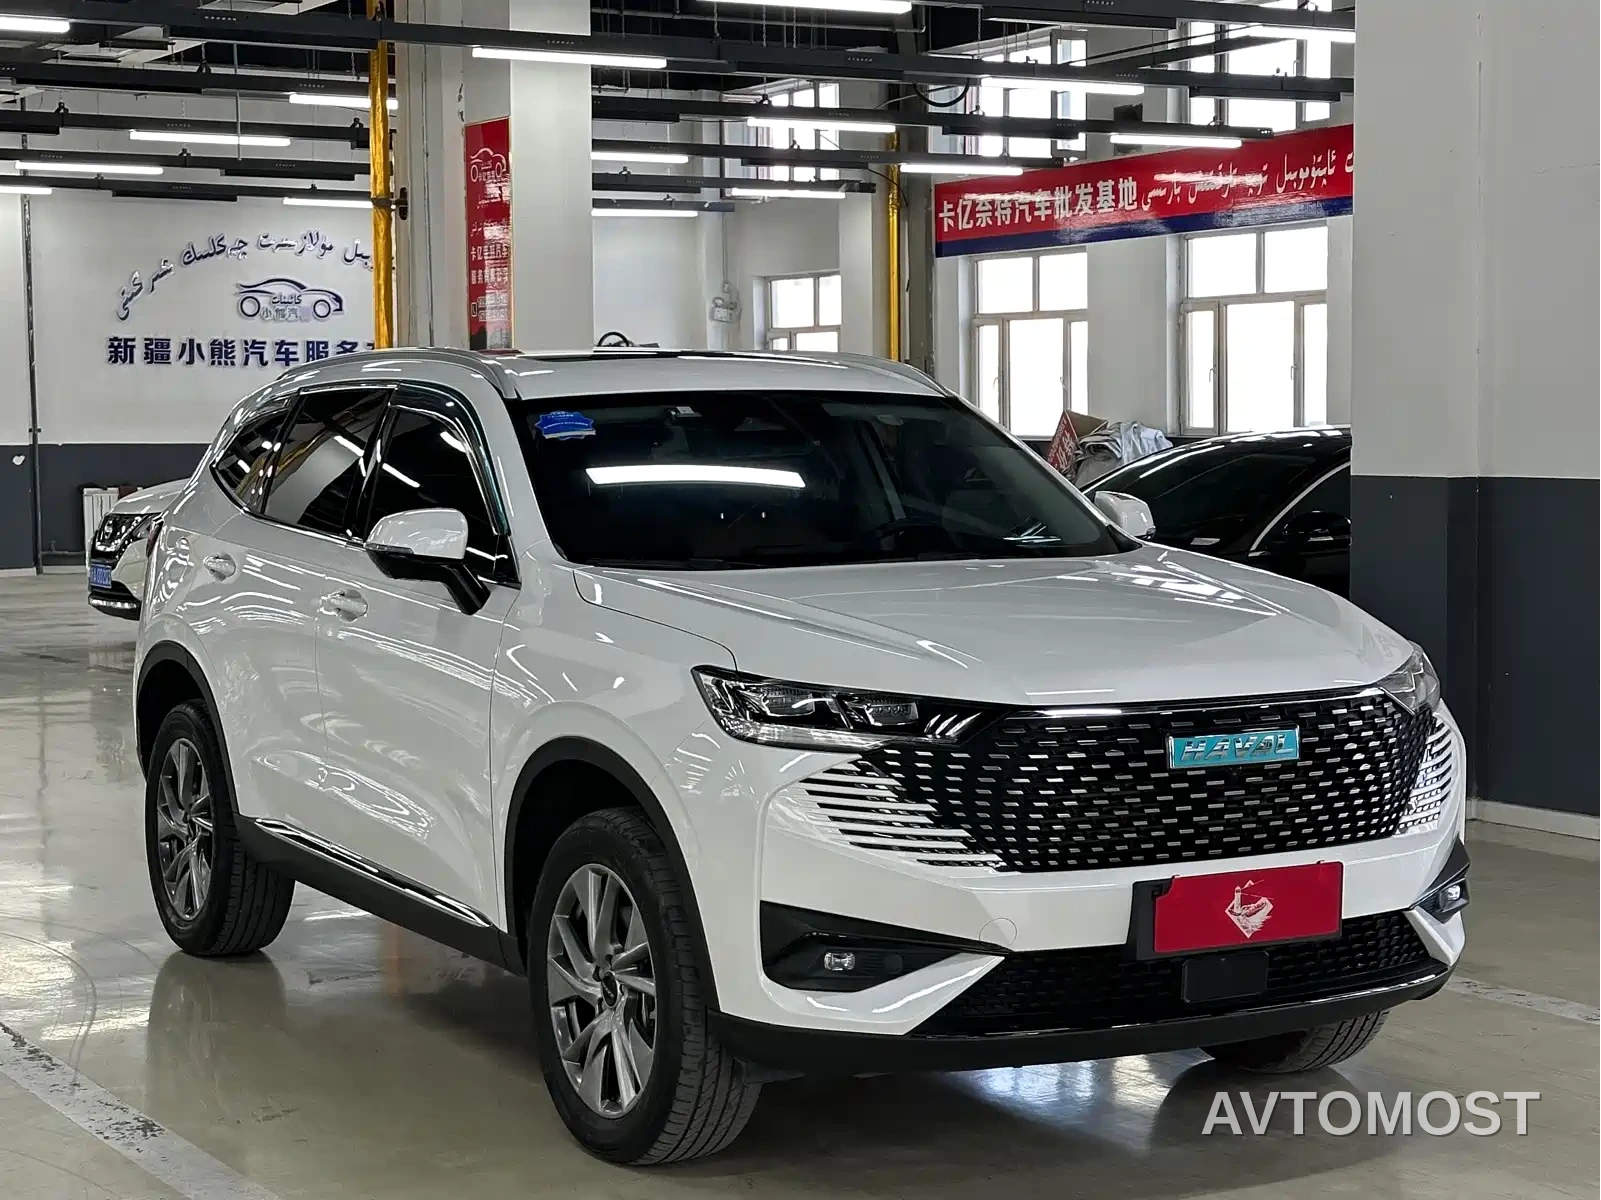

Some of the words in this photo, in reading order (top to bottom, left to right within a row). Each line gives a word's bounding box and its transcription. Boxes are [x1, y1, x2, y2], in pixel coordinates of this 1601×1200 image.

[939, 177, 1137, 232] 卡亿奈特汽车批发基地
[260, 306, 312, 321] 小熊汽
[107, 336, 375, 366] 新疆小熊汽车服务
[1181, 734, 1294, 761] HAVAL
